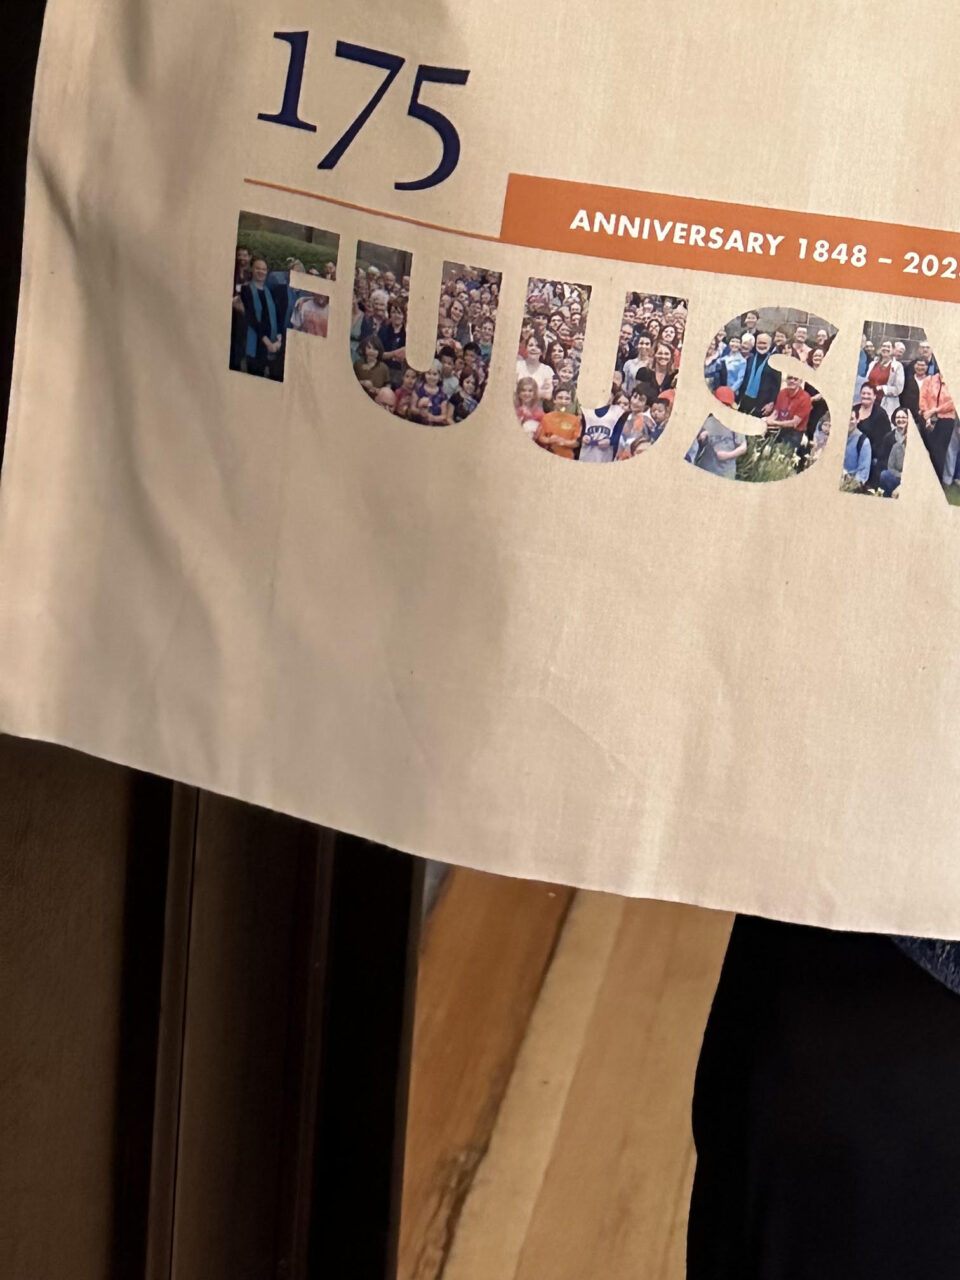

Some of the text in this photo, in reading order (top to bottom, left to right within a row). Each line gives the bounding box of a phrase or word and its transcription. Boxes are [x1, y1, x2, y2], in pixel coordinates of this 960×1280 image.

[257, 30, 471, 191] 175
[569, 208, 786, 257] ANNIVERSARY
[796, 237, 868, 269] 1848
